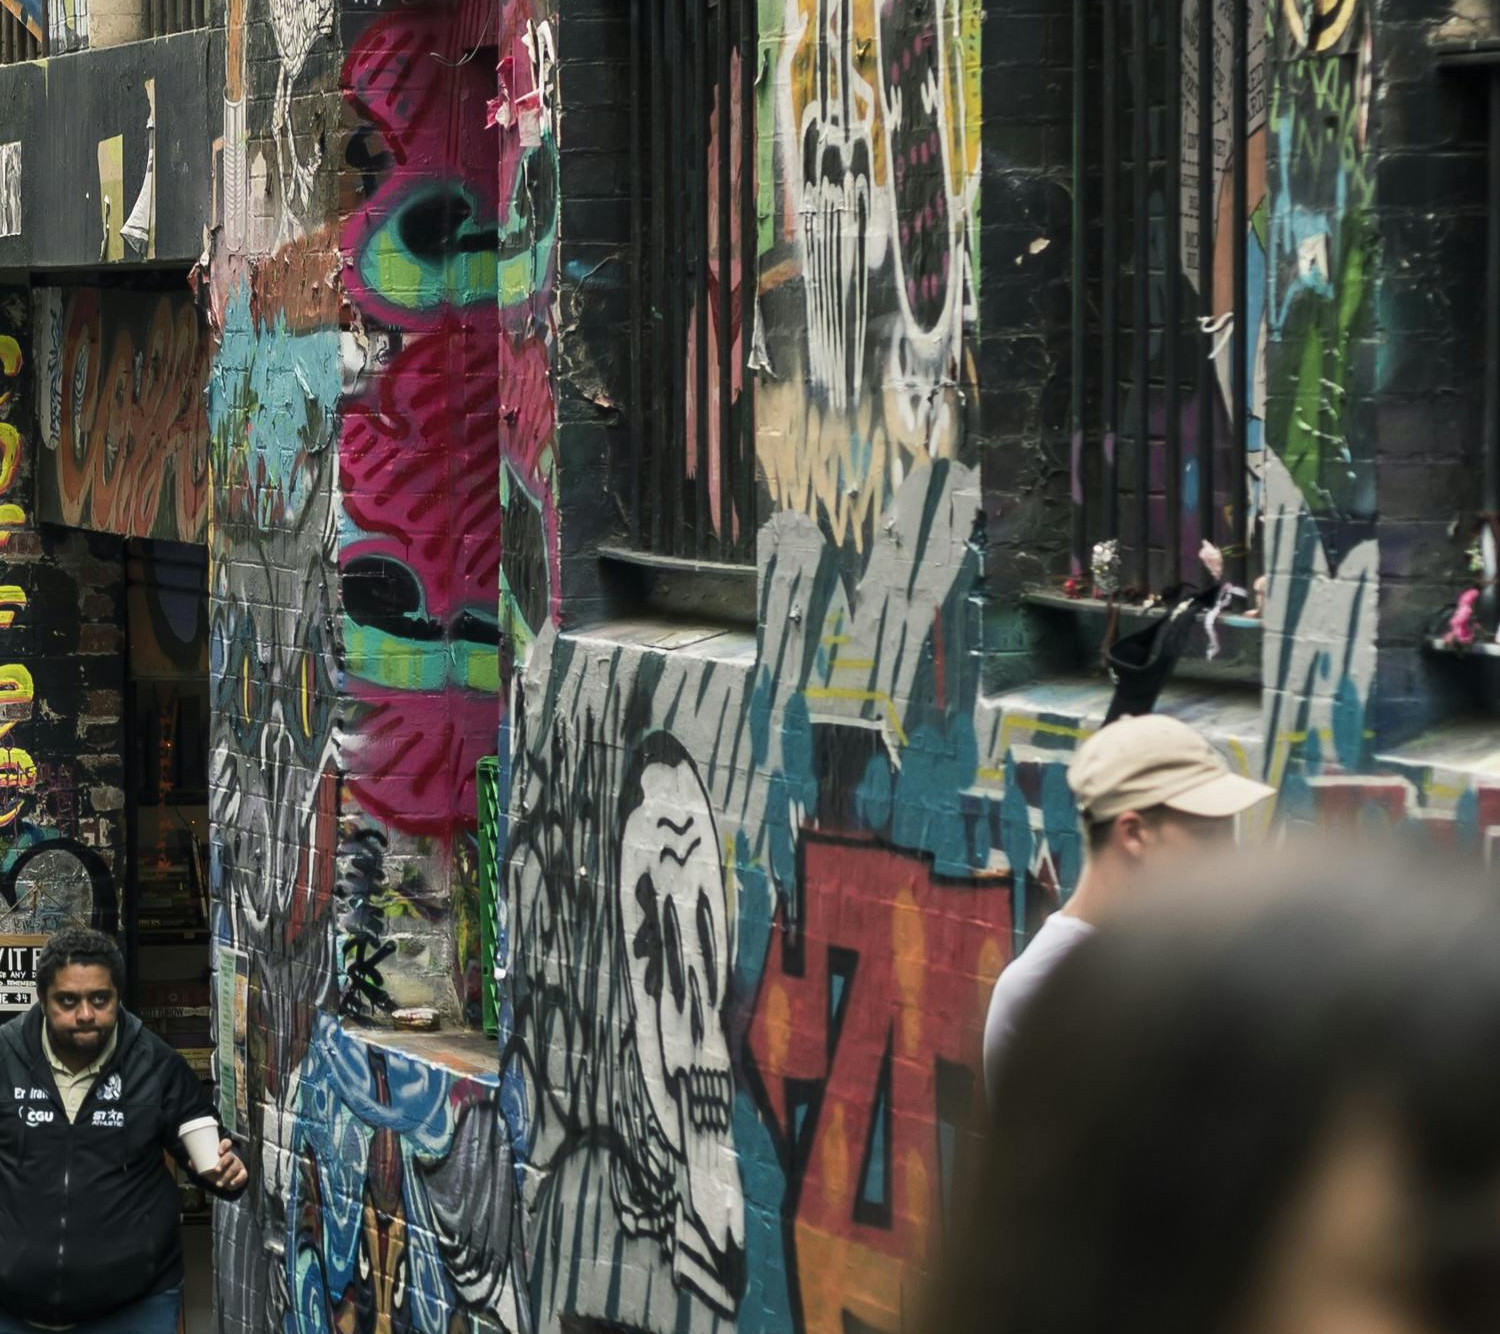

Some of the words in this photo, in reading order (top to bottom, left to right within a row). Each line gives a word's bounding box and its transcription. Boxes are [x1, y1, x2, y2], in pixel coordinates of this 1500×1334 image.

[8, 947, 27, 971] IT
[10, 971, 26, 979] ANY
[27, 1110, 54, 1122] CGU
